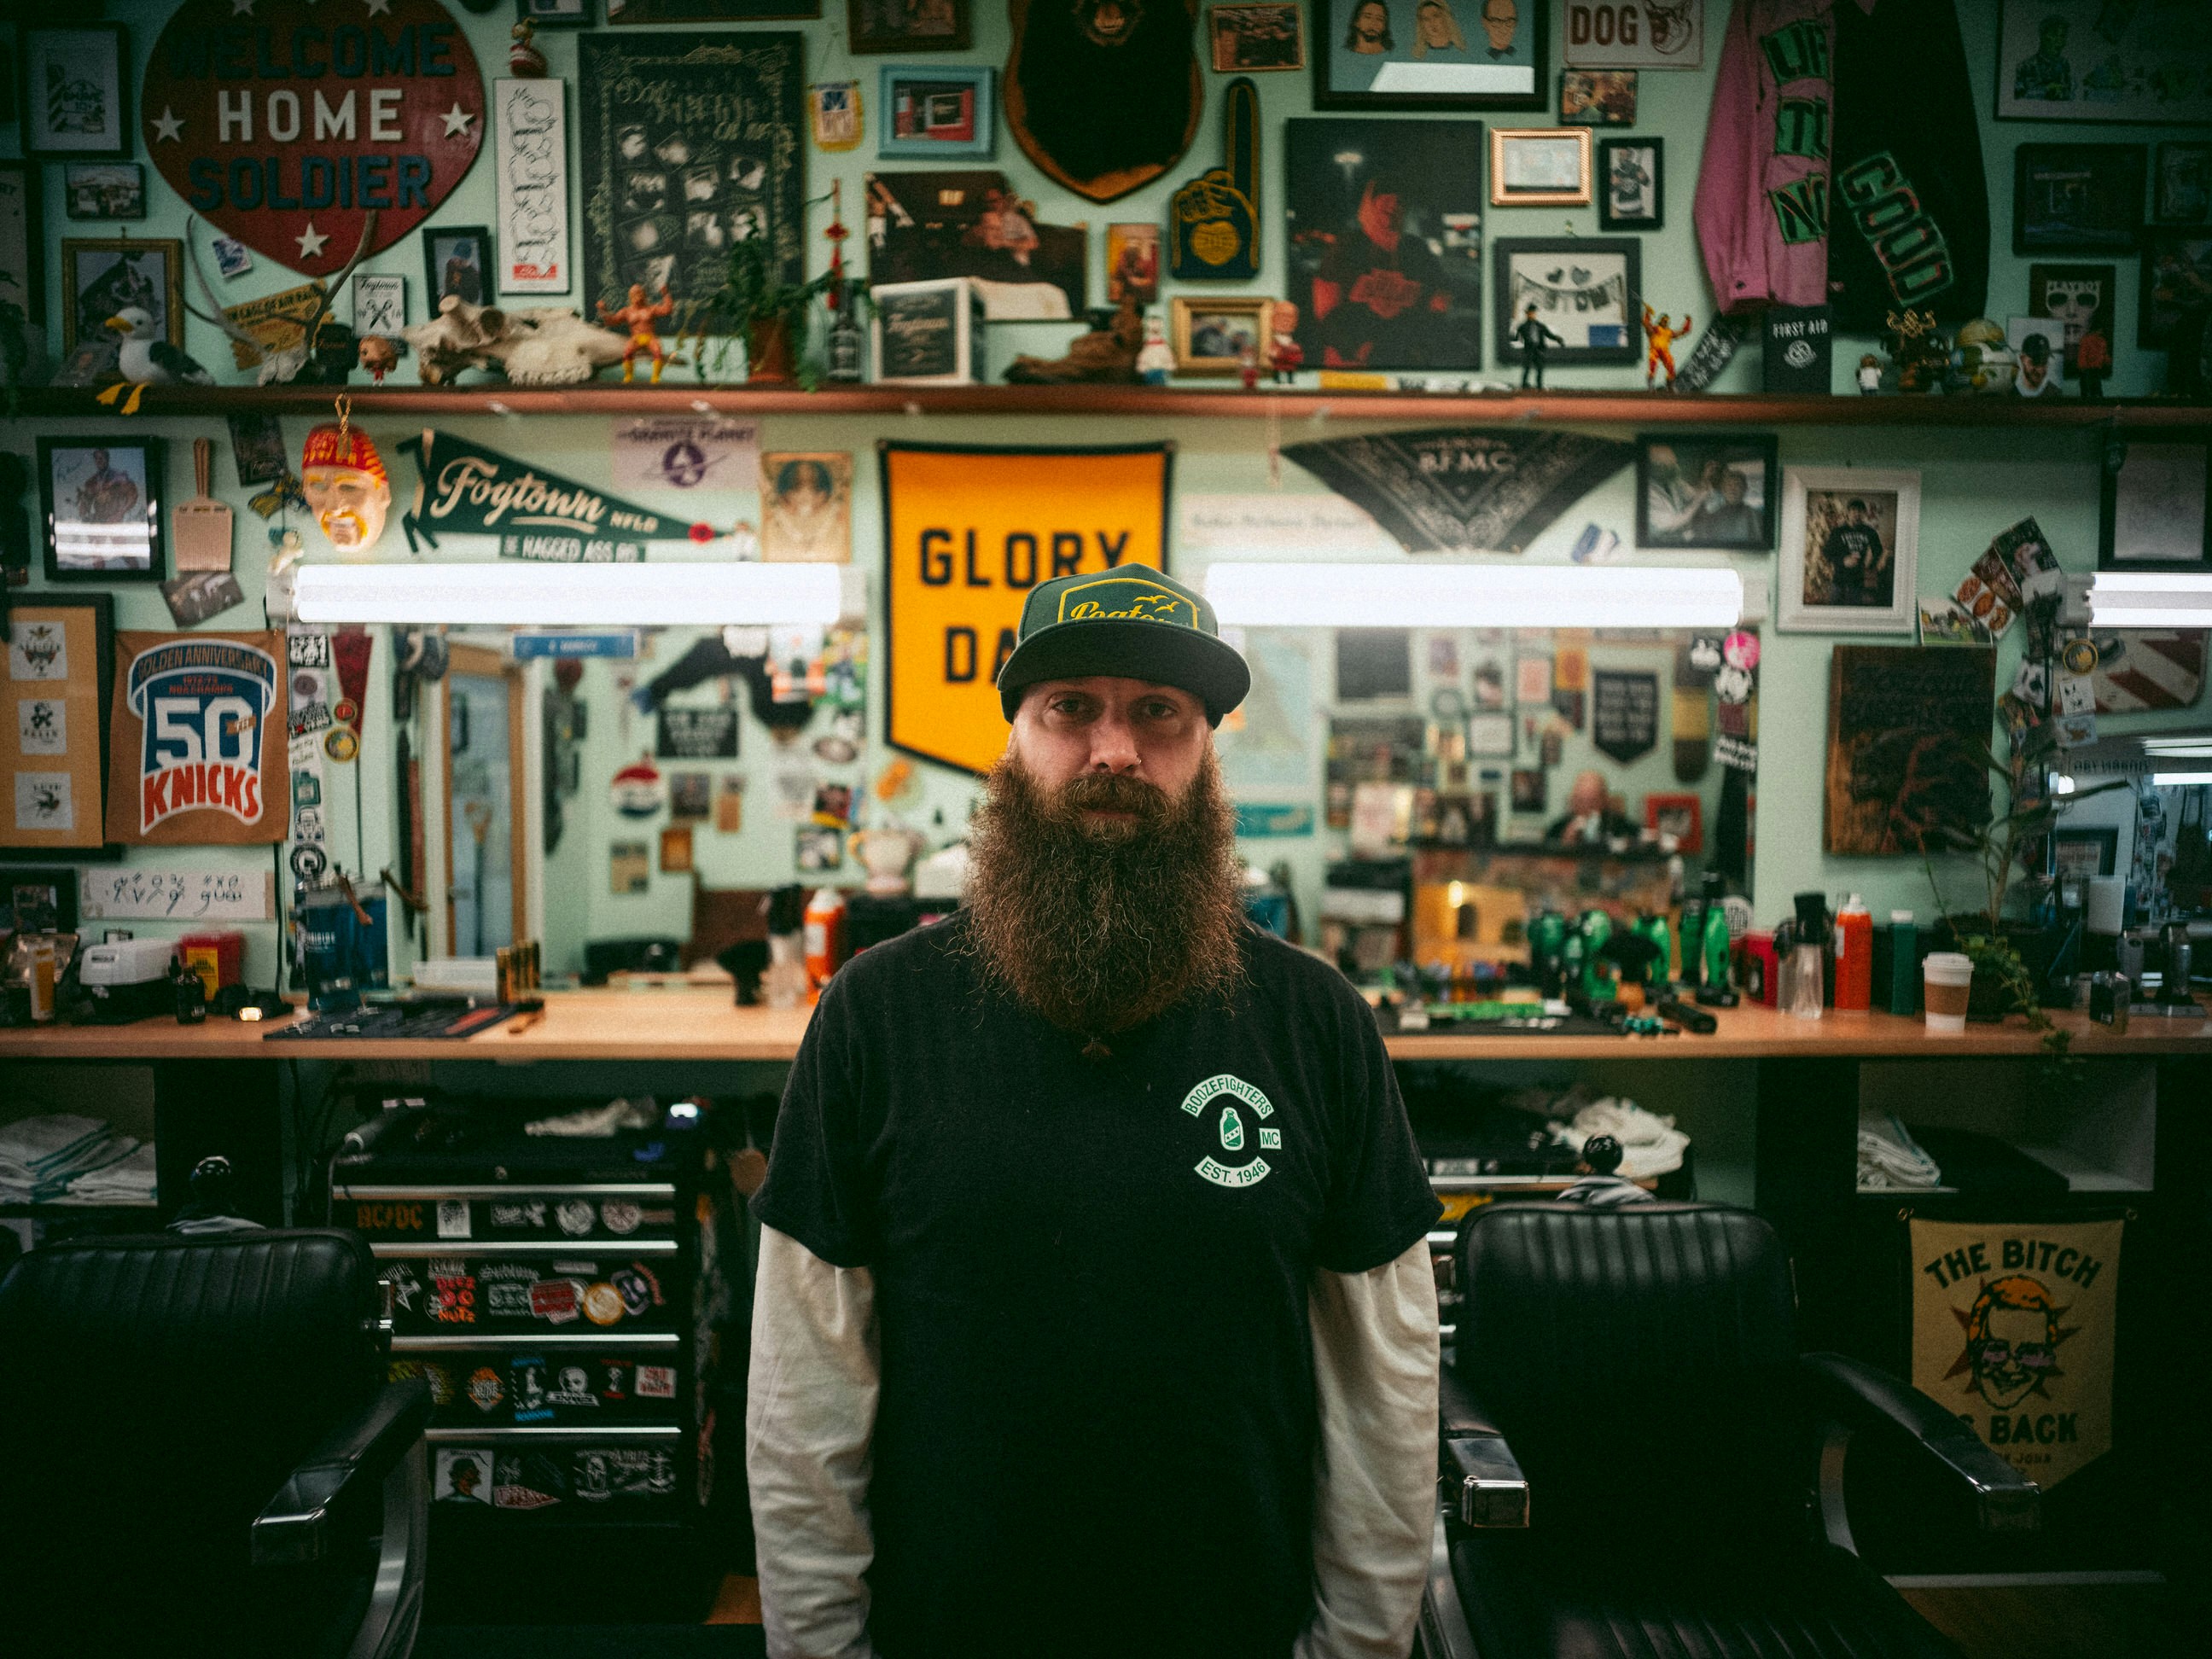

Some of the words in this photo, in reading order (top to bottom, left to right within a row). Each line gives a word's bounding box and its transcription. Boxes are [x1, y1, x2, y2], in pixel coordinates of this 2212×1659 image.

[1571, 5, 1638, 45] DOG
[169, 23, 457, 79] WELCOME
[218, 89, 403, 143] HOME
[189, 155, 432, 211] SOLDIER
[1840, 153, 1953, 305] GOOD
[1773, 321, 1804, 339] FIRST
[1807, 318, 1828, 335] AID
[428, 456, 607, 527] Fogtown
[919, 528, 1128, 590] GLORY
[138, 646, 183, 680] GOLDEN
[184, 644, 268, 678] ANNIVERSARY
[154, 696, 253, 767] 50
[144, 763, 259, 829] KNICKS
[1185, 1077, 1272, 1115] BOOZEFIGHTERS
[1261, 1132, 1279, 1145] MC
[1201, 1161, 1232, 1184] EST.
[1236, 1161, 1266, 1184] 1946
[1924, 1243, 1991, 1289] THE
[2002, 1240, 2104, 1289] BITCH
[1989, 1412, 2079, 1445] BACK
